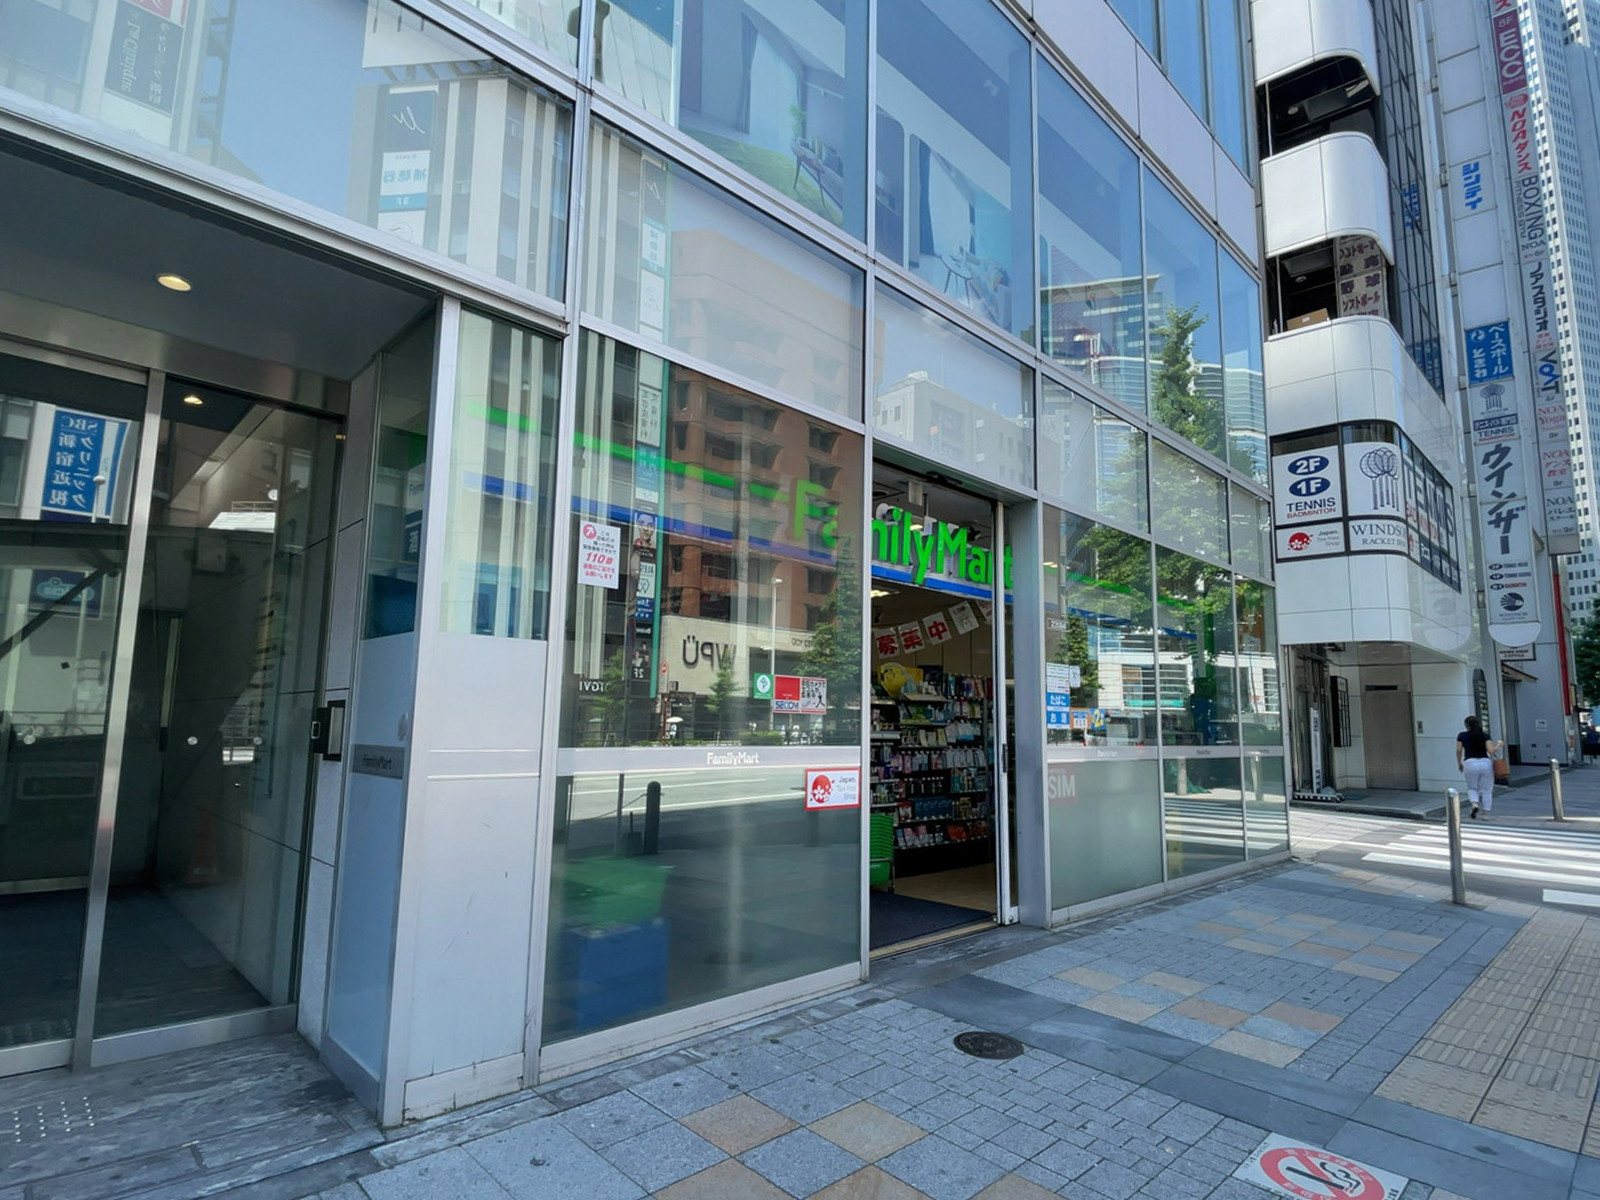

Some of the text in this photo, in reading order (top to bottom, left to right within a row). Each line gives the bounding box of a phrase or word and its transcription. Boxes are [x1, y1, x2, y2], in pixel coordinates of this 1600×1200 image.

[1499, 28, 1524, 78] ECC
[1521, 174, 1545, 241] BOXING
[1296, 456, 1321, 474] 2F
[1297, 478, 1323, 493] 1F
[1286, 496, 1336, 513] TENNIS
[1481, 443, 1526, 555] ウインザー
[1286, 506, 1337, 519] BADMINTON
[876, 620, 948, 657] 募集中
[707, 752, 760, 765] FamilyMart
[1048, 774, 1076, 799] SIM
